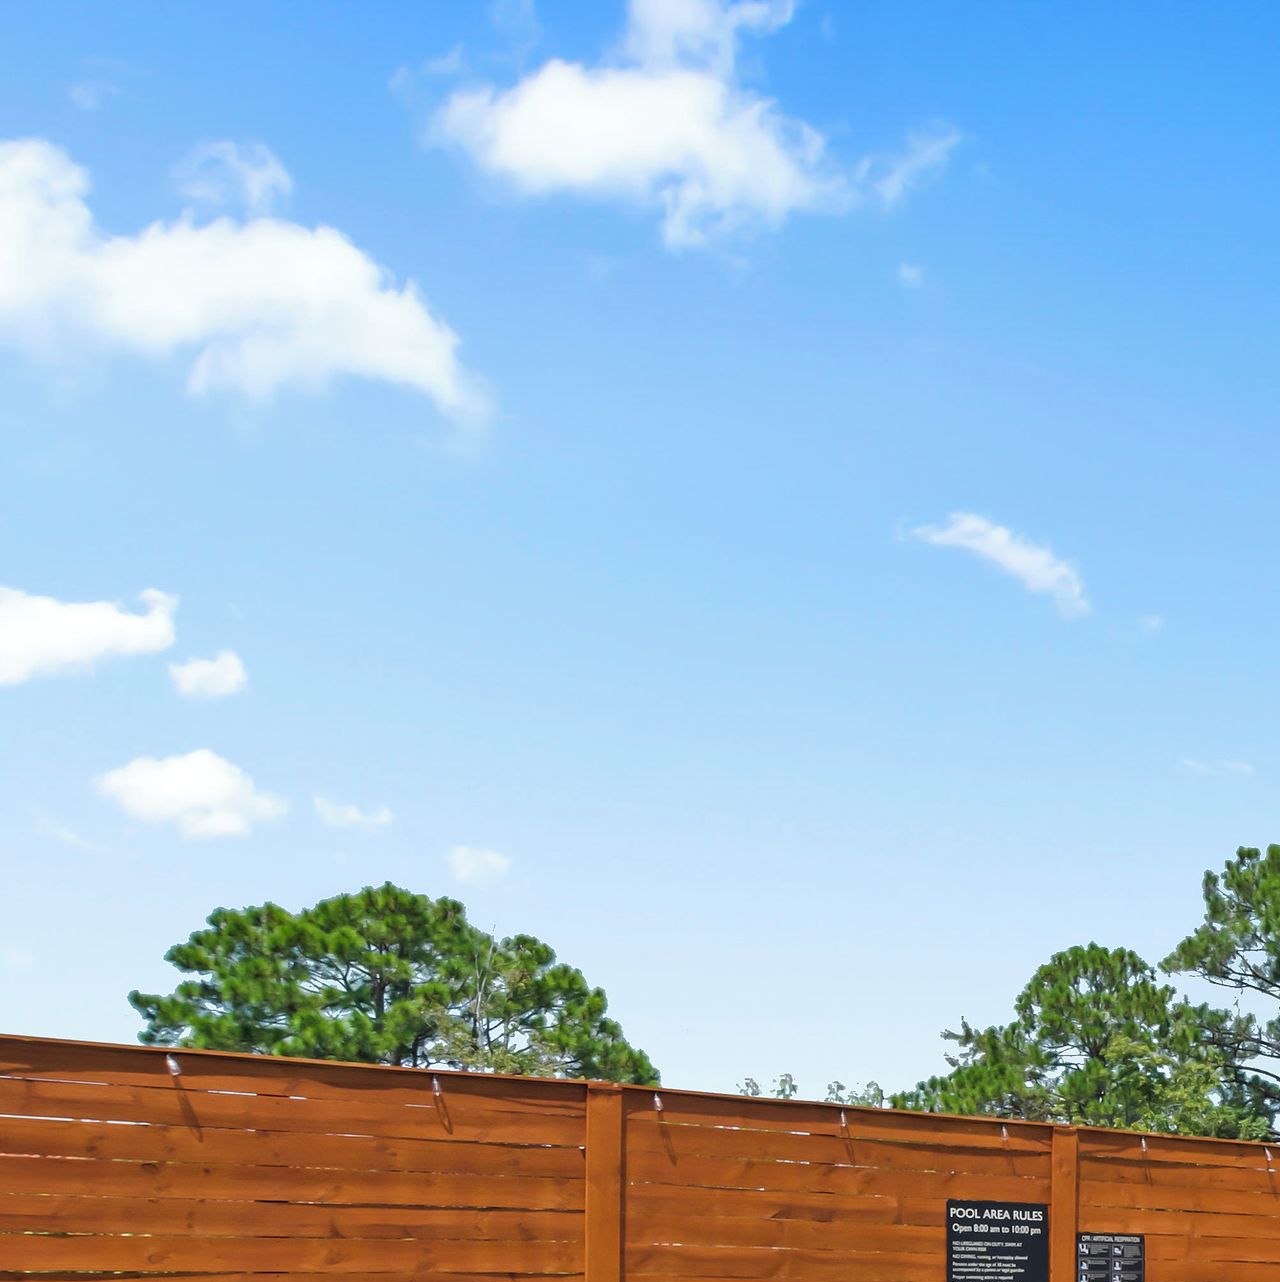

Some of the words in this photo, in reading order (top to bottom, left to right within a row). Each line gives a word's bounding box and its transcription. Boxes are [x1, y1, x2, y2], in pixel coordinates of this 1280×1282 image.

[950, 1207, 981, 1219] POOL
[982, 1209, 1011, 1220] AREA
[1013, 1210, 1043, 1221] RULES
[952, 1223, 972, 1234] Open
[1030, 1227, 1041, 1236] pm
